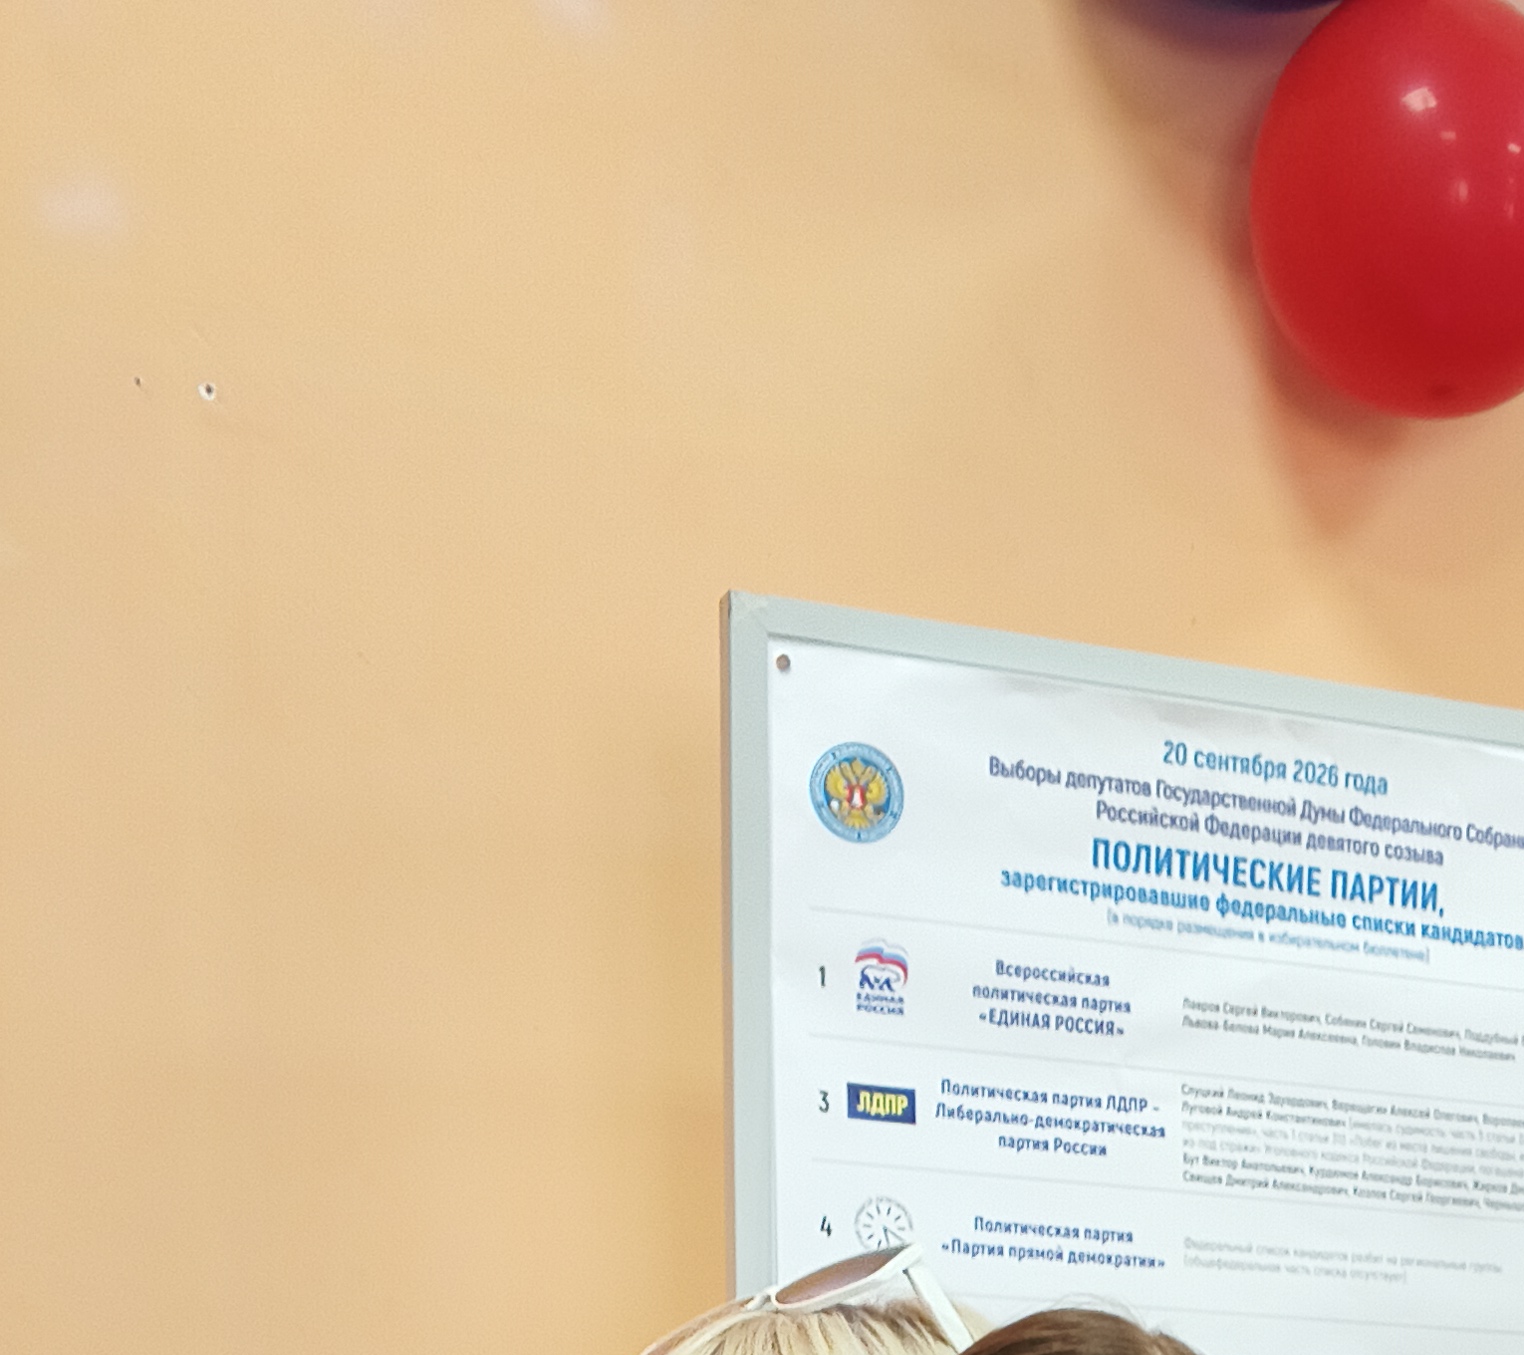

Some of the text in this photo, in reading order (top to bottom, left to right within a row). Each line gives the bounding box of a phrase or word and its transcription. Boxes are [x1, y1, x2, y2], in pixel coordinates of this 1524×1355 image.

[1162, 739, 1388, 798] 20 сентября 2026 года
[988, 754, 1061, 788] Выборы
[1064, 769, 1151, 801] депутатов
[1155, 778, 1296, 821] Государственной
[1299, 798, 1345, 829] Думы
[1348, 805, 1462, 843] Федерального
[1096, 799, 1444, 866] Российской Федерации девятого созыва
[1092, 838, 1443, 913] ПОЛИТИЧЕСКИЕ ПАРТИИ,
[1001, 869, 1524, 953] зарегистрировавшие федеральные списки кандидатов
[818, 966, 827, 988] 1
[995, 959, 1109, 988] Всероссийская
[972, 984, 1131, 1016] политическая партия
[978, 1007, 1124, 1037] «ЕДИНАЯ РОССИЯ»
[818, 1091, 830, 1112] 3
[856, 1091, 909, 1116] ЛДПР
[940, 1078, 1147, 1115] Политическая партия ЛДПР
[935, 1102, 1165, 1140] Либерально-демократическая
[998, 1135, 1106, 1157] партия России
[820, 1217, 832, 1237] 4
[974, 1216, 1133, 1245] Политическая партия
[941, 1238, 1164, 1270] «Партия прямой демократии»
